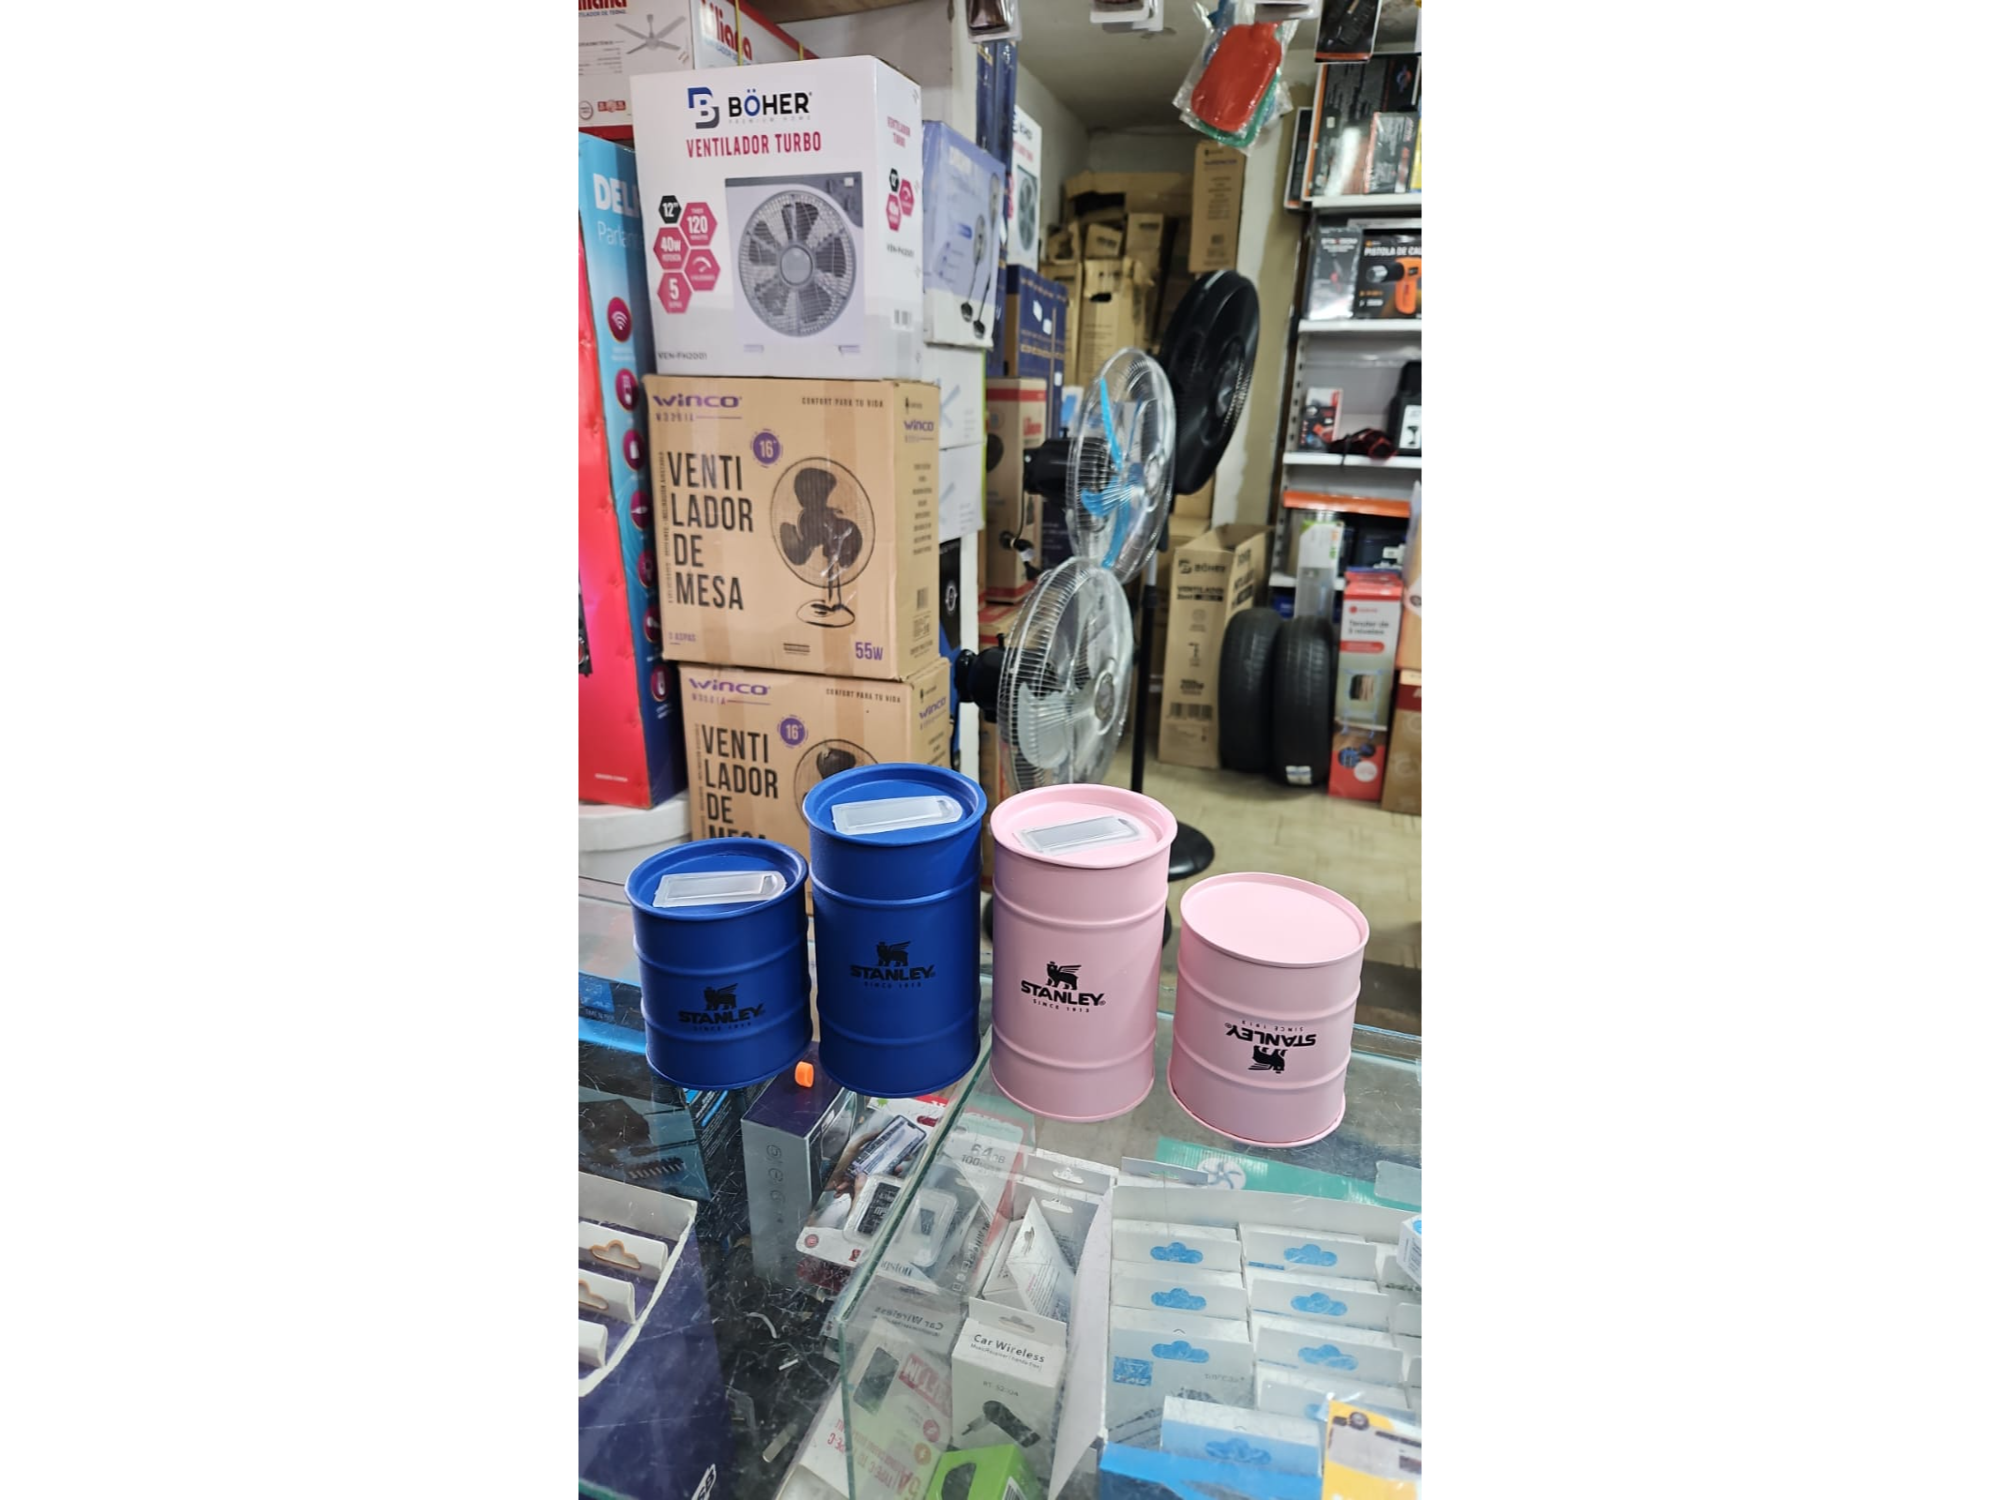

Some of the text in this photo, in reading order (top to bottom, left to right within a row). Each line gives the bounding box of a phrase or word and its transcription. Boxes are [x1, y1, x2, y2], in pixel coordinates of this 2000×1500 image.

[728, 89, 810, 117] BÖHER
[686, 131, 822, 158] VENTILADOR TURBO
[686, 215, 709, 235] 120
[668, 277, 680, 300] 5
[667, 451, 742, 491] VENTI
[671, 492, 753, 533] LADOR
[673, 533, 704, 568] DE
[675, 571, 744, 610] MESA
[701, 724, 769, 764] VENTI
[704, 759, 779, 800] LADOR
[706, 792, 735, 824] DE
[850, 964, 936, 981] STANLEY
[1021, 979, 1105, 1006] STANLEY
[1032, 998, 1060, 1010] SINCE
[677, 1003, 765, 1025] STANLEY
[1225, 1024, 1317, 1048] STANLEY
[1274, 1025, 1304, 1033] SINCE
[973, 1334, 1045, 1363] Car Wireless
